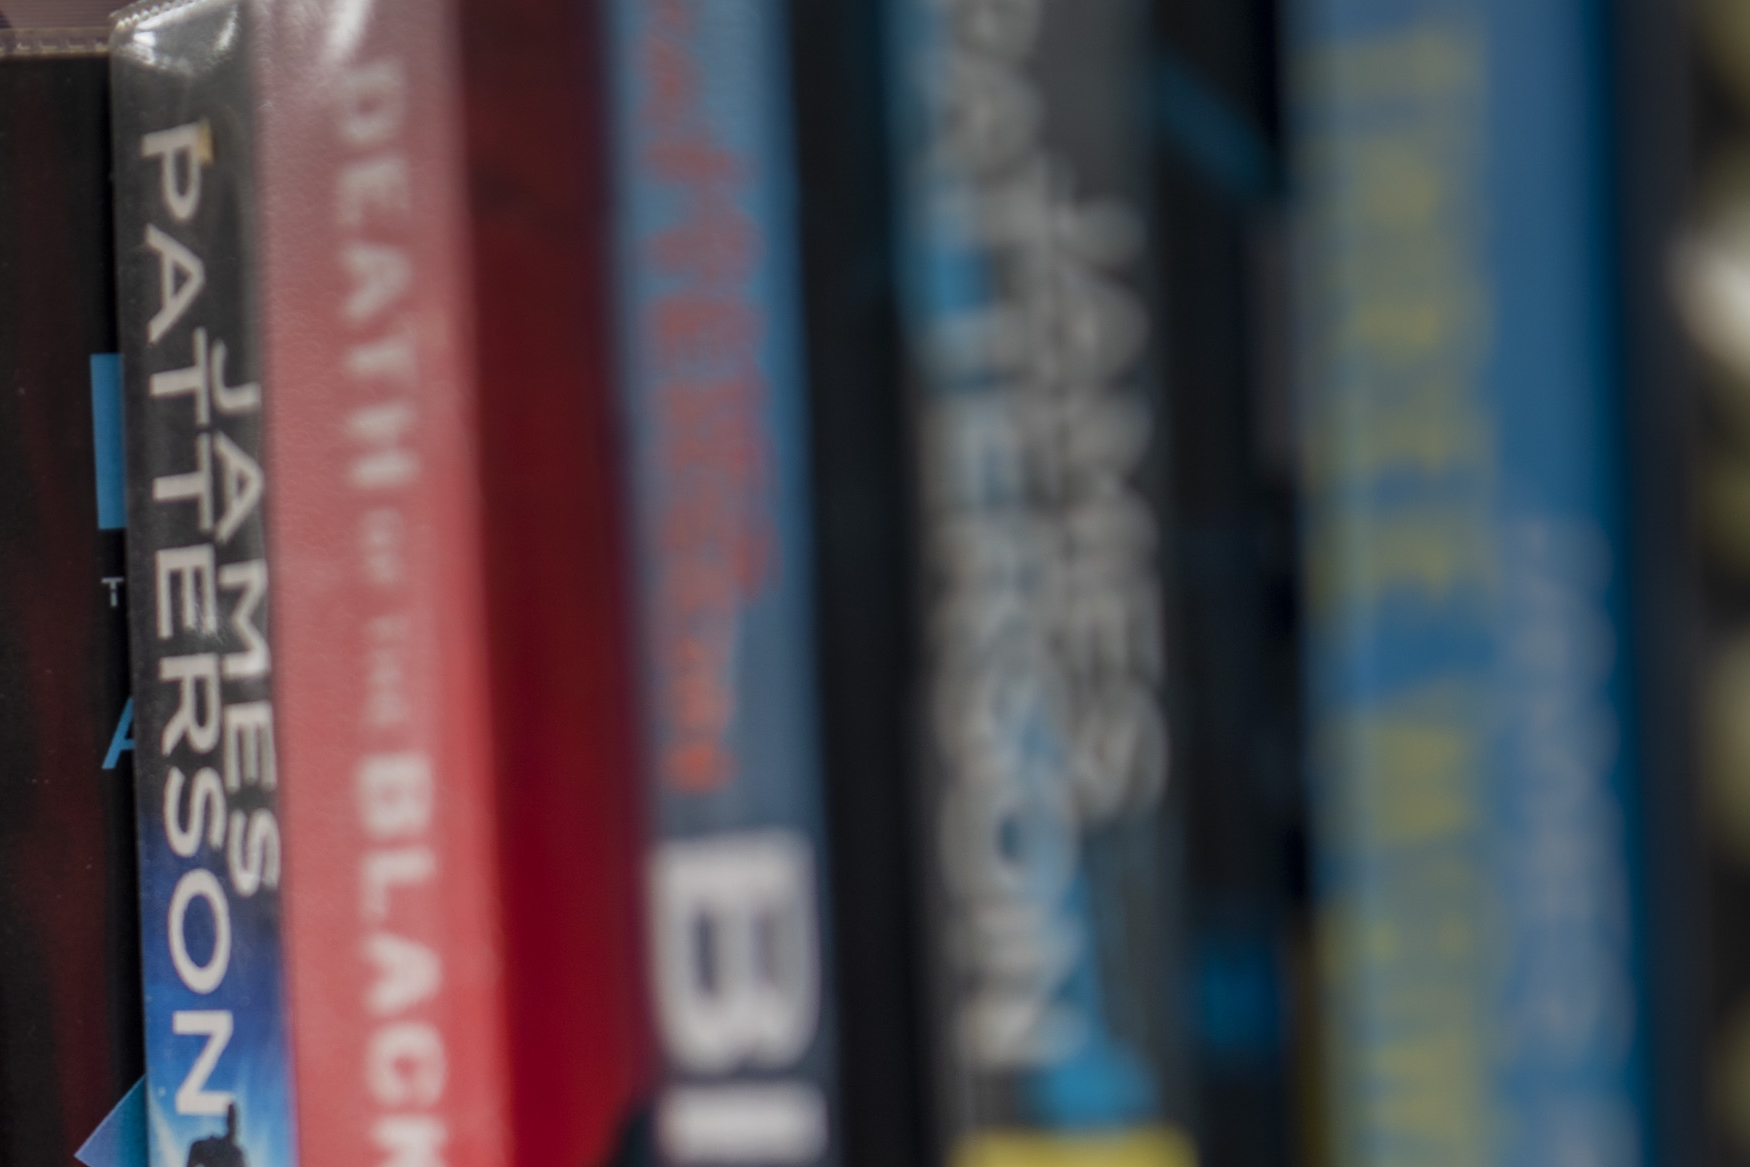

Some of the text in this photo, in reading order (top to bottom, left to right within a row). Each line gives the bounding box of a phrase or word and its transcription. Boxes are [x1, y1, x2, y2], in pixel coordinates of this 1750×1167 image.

[340, 56, 422, 491] DEATH
[140, 120, 235, 1117] PATTERSON
[210, 340, 282, 898] JAMES
